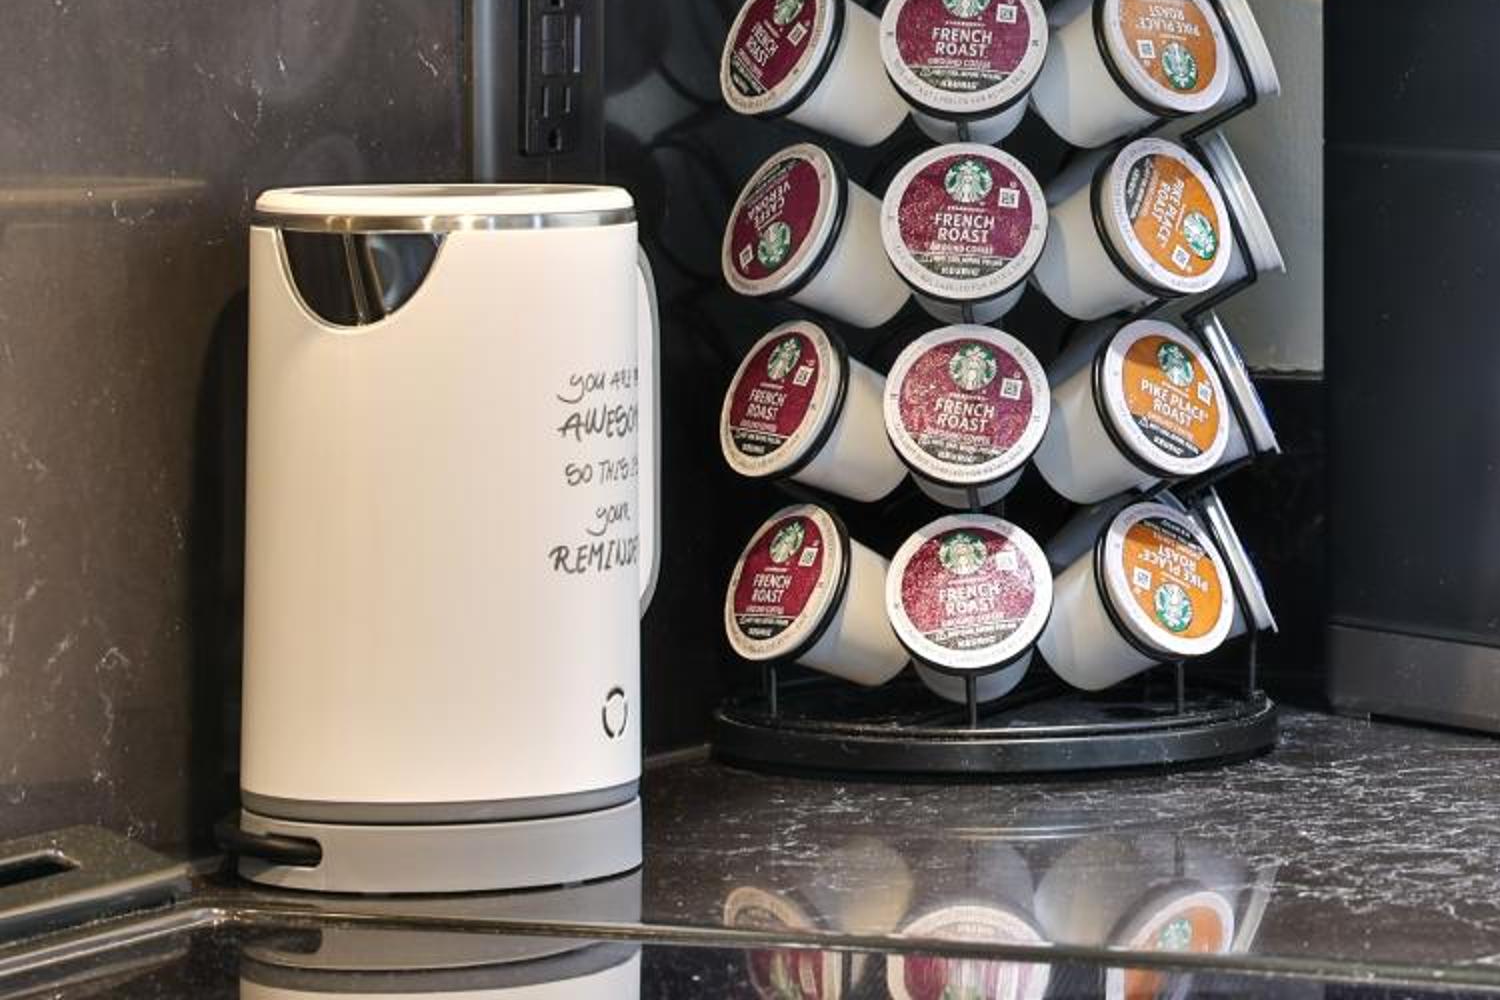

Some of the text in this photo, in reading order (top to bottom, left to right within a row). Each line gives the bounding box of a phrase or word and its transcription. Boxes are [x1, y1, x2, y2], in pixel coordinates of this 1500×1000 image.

[1148, 4, 1184, 20] ROAST
[931, 26, 993, 45] FRENCH
[935, 41, 986, 58] ROAST
[1150, 181, 1174, 221] ROAST
[1168, 177, 1185, 207] PIKE
[934, 212, 995, 229] FRENCH
[937, 227, 990, 243] ROAST
[750, 388, 787, 407] FRENCH
[1141, 379, 1169, 401] PIKE
[745, 403, 779, 421] ROAST
[934, 397, 995, 419] FRENCH
[1152, 398, 1192, 428] ROAST
[936, 414, 989, 433] ROAST
[564, 463, 592, 486] SO
[1156, 543, 1198, 573] ROAST
[752, 573, 792, 589] FRENCH
[939, 580, 1001, 599] FRENCH
[752, 590, 784, 602] ROAST
[945, 597, 995, 616] ROAST
